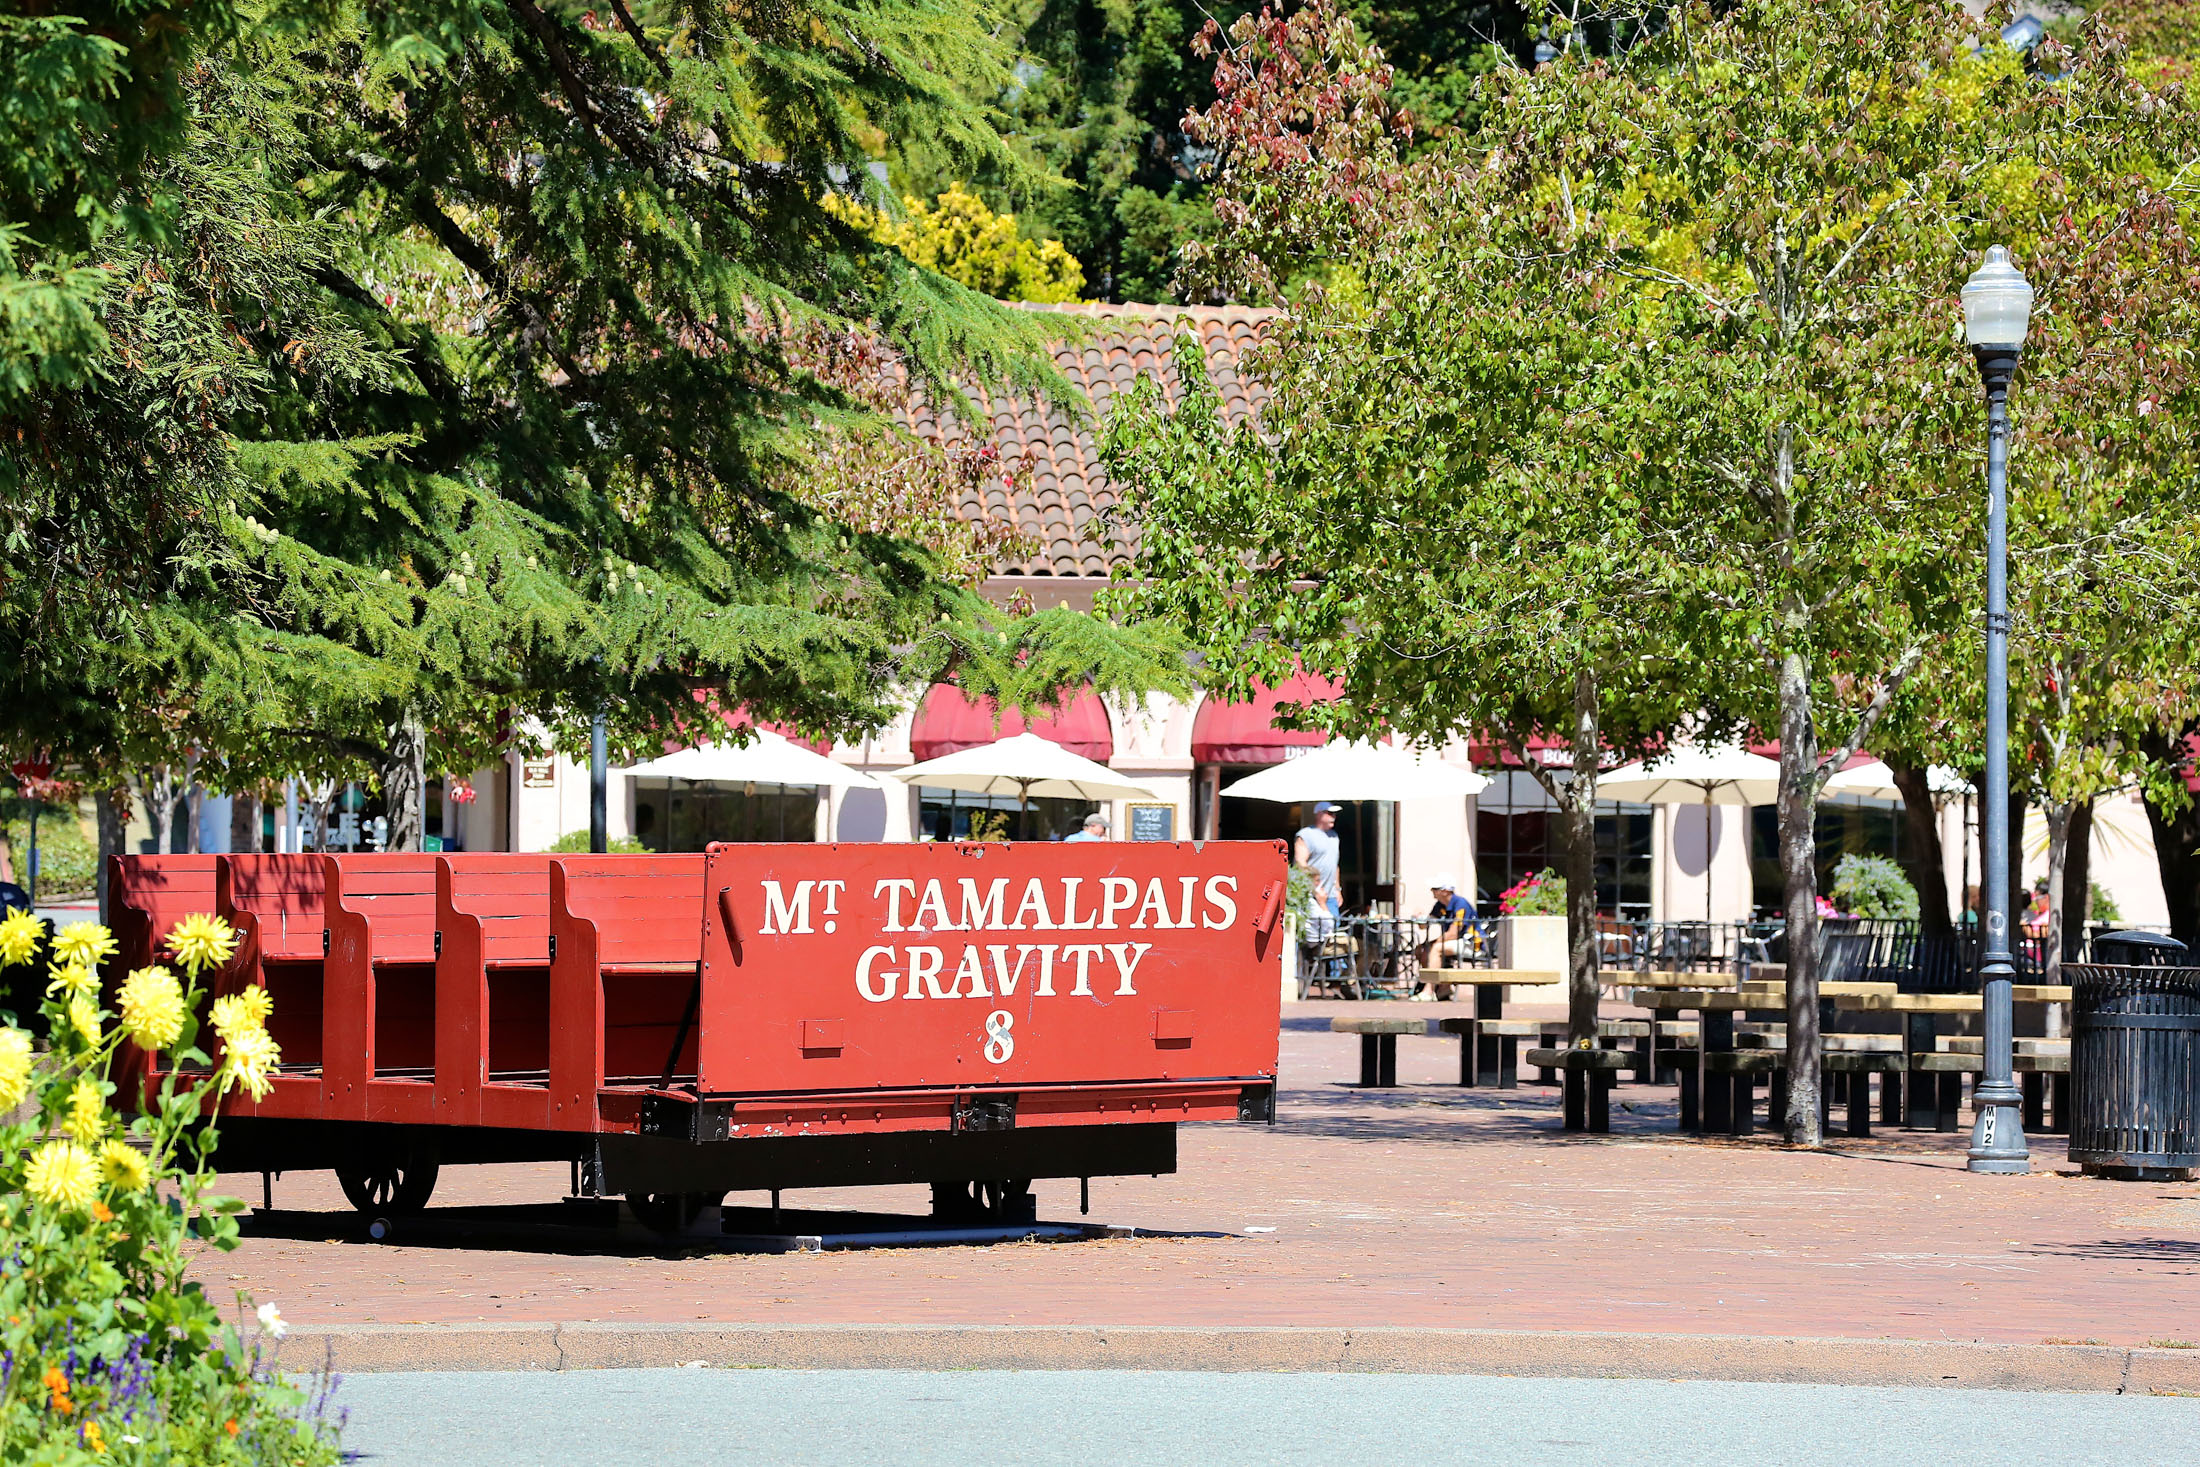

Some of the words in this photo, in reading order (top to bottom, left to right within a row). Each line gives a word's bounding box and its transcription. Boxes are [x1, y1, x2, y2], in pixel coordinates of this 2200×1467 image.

[873, 874, 1239, 932] TAMALPAIS
[855, 942, 1153, 1003] GRAVITY
[983, 1009, 1015, 1064] 8
